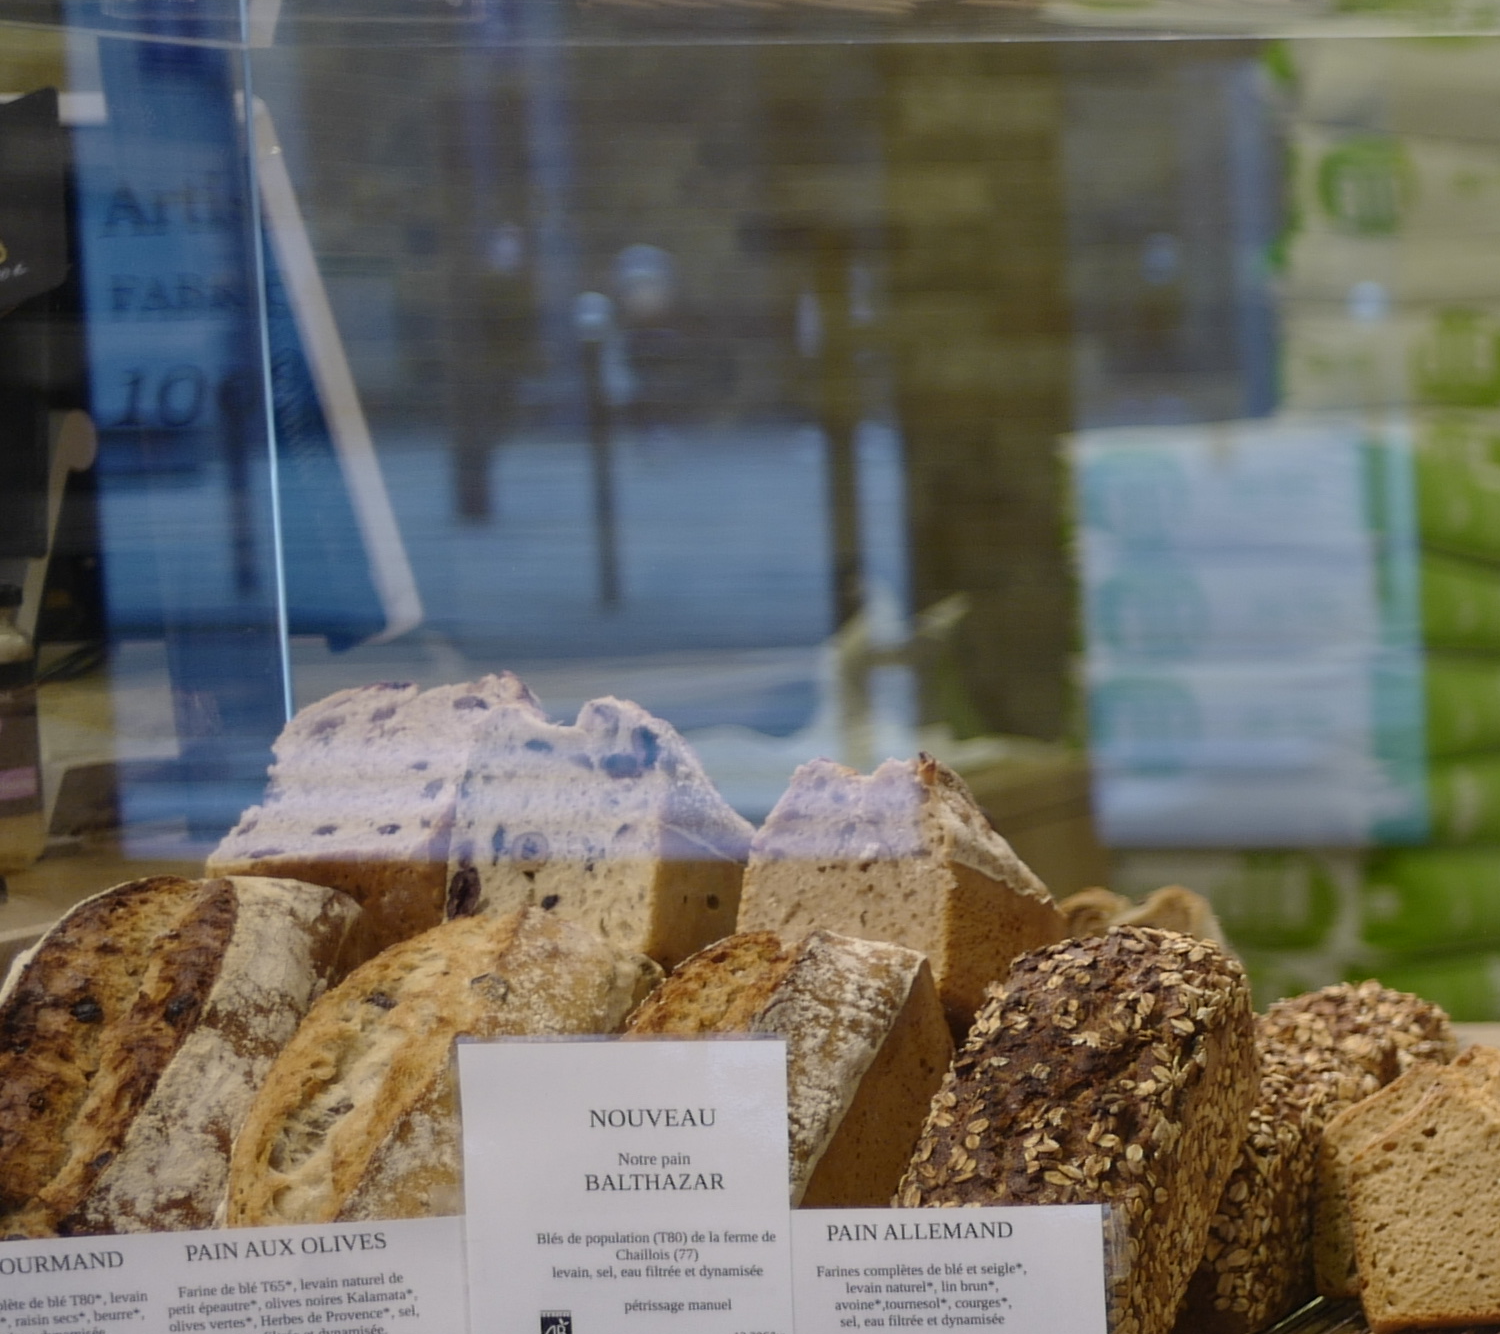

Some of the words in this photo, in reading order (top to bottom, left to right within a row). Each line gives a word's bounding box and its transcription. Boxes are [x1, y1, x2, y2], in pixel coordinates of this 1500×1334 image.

[589, 1108, 715, 1128] NOUVEAU
[618, 1152, 658, 1167] Notre
[661, 1152, 691, 1170] pain
[584, 1173, 725, 1192] BALTHAZAR
[536, 1232, 564, 1245] Blés
[567, 1232, 582, 1245] de
[585, 1231, 651, 1248] population
[653, 1231, 688, 1246] (T80)
[690, 1230, 706, 1244] de
[708, 1230, 720, 1243] la
[723, 1230, 759, 1243] ferme
[761, 1230, 777, 1243] de
[826, 1223, 877, 1242] PAIN
[884, 1221, 1013, 1241] ALLEMAND
[184, 1242, 238, 1262] PAIN
[245, 1238, 295, 1259] AUX
[301, 1232, 387, 1255] OLIVES
[615, 1248, 671, 1261] Chaillois
[673, 1248, 699, 1263] (77)
[552, 1266, 593, 1280] levain,
[596, 1265, 618, 1280] sel,
[620, 1268, 642, 1278] eau
[645, 1265, 682, 1278] filtrée
[684, 1267, 696, 1277] et
[698, 1264, 764, 1280] dynamisée
[816, 1265, 861, 1278] Farines
[863, 1263, 924, 1280] complètes
[926, 1263, 942, 1276] de
[944, 1262, 964, 1276] blé
[966, 1264, 978, 1275] et
[177, 1285, 218, 1299] Farine
[220, 1283, 236, 1296] de
[237, 1281, 258, 1295] blé
[299, 1277, 339, 1291] levain
[341, 1272, 385, 1288] naturel
[388, 1271, 404, 1284] de
[845, 1281, 883, 1294] levain
[941, 1280, 958, 1293] lin
[28, 1296, 45, 1310] de
[46, 1295, 67, 1309] blé
[110, 1290, 148, 1304] levain
[167, 1304, 195, 1317] petit
[264, 1297, 302, 1314] olives
[304, 1293, 343, 1308] noires
[624, 1299, 685, 1315] pétrissage
[687, 1298, 732, 1311] manuel
[169, 1320, 206, 1333] olives
[260, 1313, 304, 1327] Herbes
[307, 1311, 322, 1323] de
[398, 1304, 420, 1318] sel,
[839, 1315, 861, 1329] sel,
[863, 1318, 885, 1327] eau
[888, 1314, 924, 1327] filtrée
[926, 1316, 938, 1326] et
[940, 1312, 1005, 1329] dynamisée
